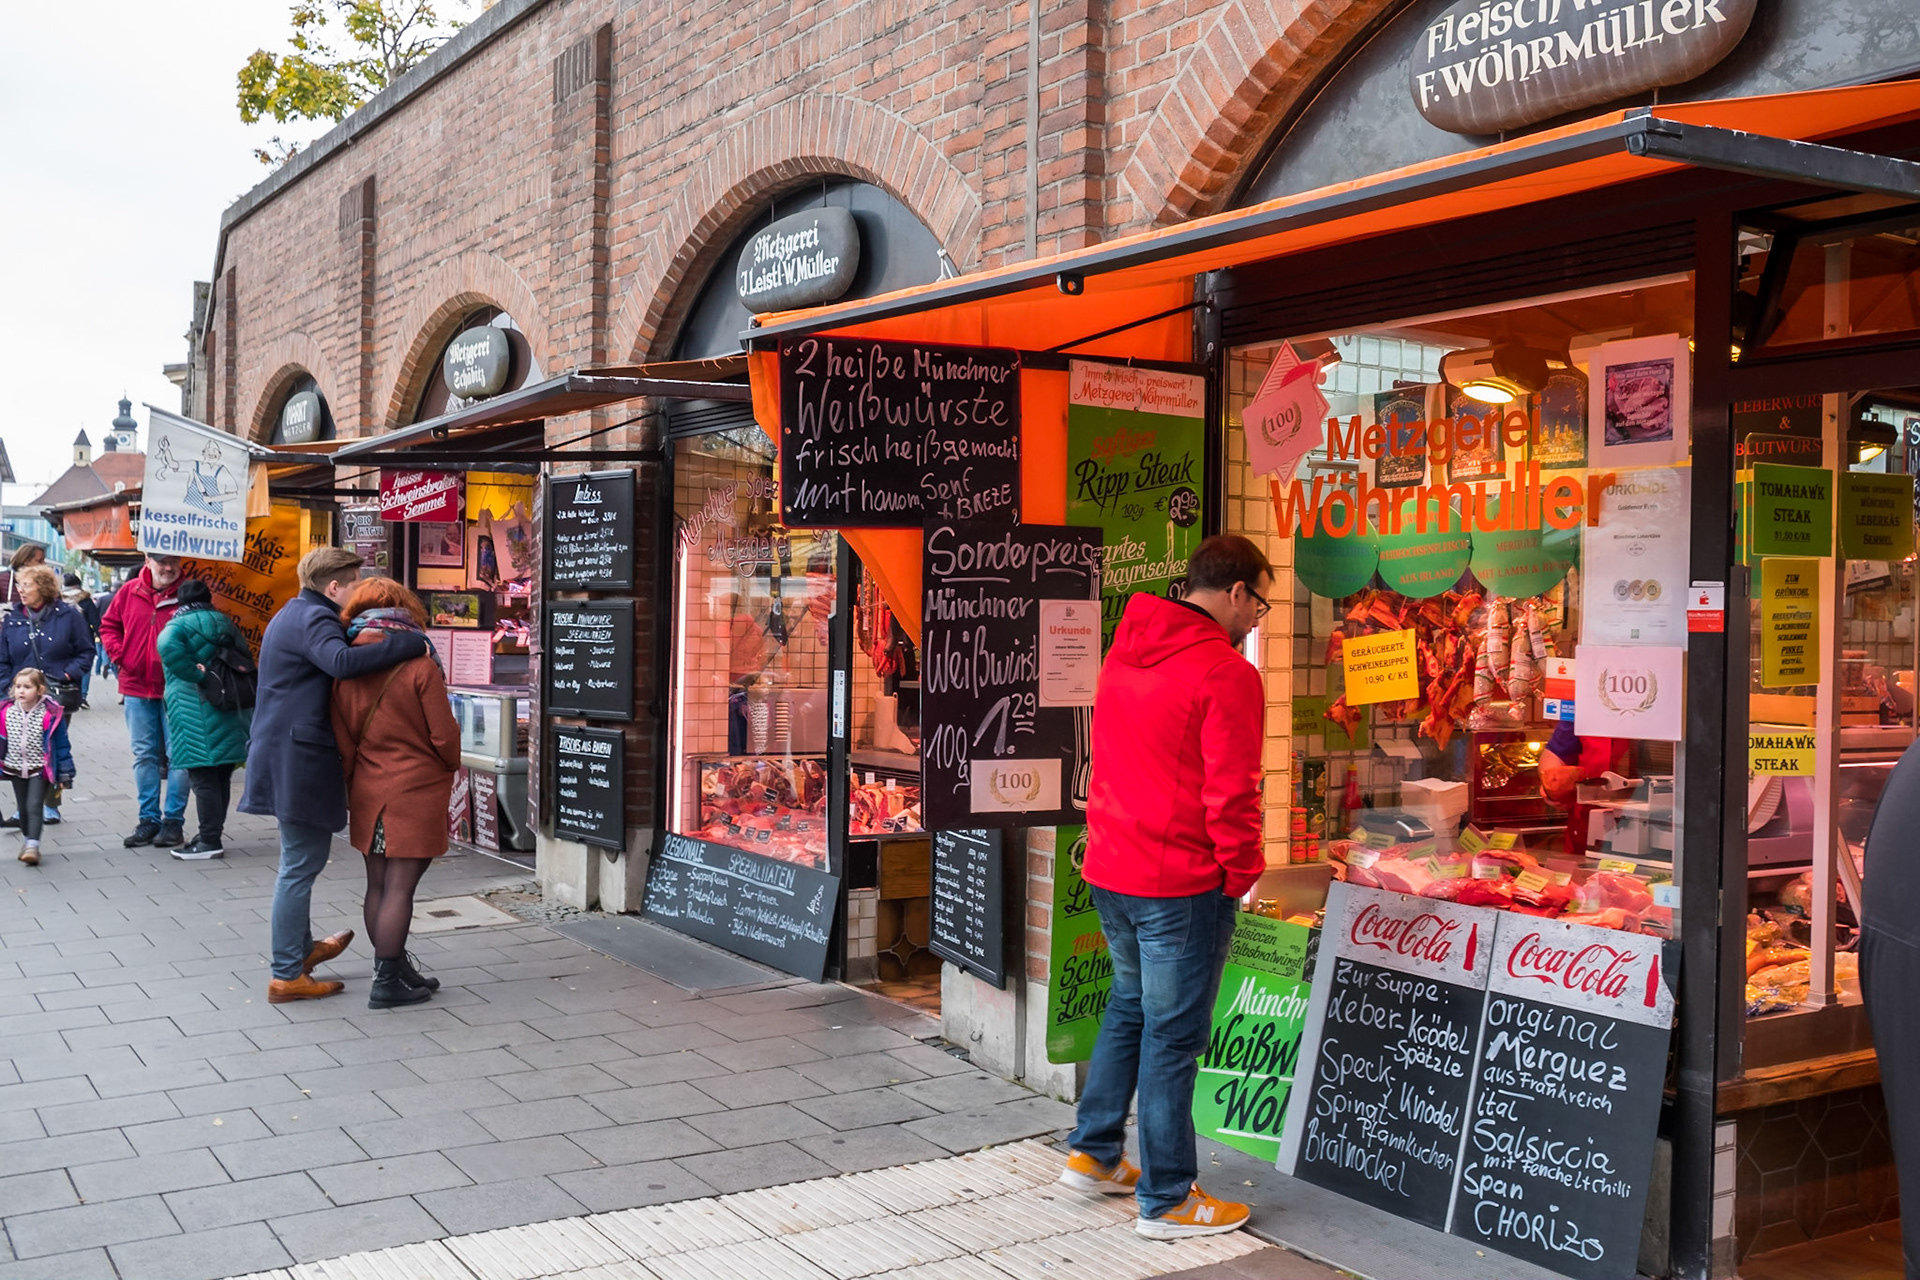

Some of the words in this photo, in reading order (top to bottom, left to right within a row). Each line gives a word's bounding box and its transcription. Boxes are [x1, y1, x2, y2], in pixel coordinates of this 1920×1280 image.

[754, 219, 820, 267] Metzgerei
[795, 339, 818, 378] 2
[826, 343, 906, 385] heiße
[913, 348, 1011, 383] Münchner
[798, 378, 1009, 441] Weißwürste
[1073, 381, 1136, 406] Metzgerei
[1136, 387, 1199, 414] Wöhrmüller
[1266, 407, 1295, 433] 100
[1326, 396, 1541, 465] Metzgerei
[1779, 416, 1792, 430] &
[795, 437, 878, 471] frisch
[1735, 439, 1821, 457] BLUTWURS
[573, 484, 602, 501] Imbiss
[1271, 461, 1617, 538] Wöhrmüller
[1760, 482, 1825, 500] TOMAHAWK
[144, 508, 239, 531] kesselfrische
[1773, 508, 1812, 524] STEAK
[143, 525, 239, 559] Weißwurst
[927, 526, 1093, 582] Sonderpreis
[1102, 535, 1148, 562] artes
[1399, 572, 1418, 585] AUS
[1419, 567, 1455, 582] IRLAND
[925, 587, 1034, 622] Münchner
[1050, 625, 1092, 636] Urkunde
[1351, 642, 1406, 658] GERÄUCHERTE
[1349, 656, 1409, 673] SCHWEINERIPPEN
[1364, 674, 1385, 685] 10,90
[1608, 674, 1648, 694] 100
[1748, 735, 1816, 749] OMAHAWK
[1754, 758, 1800, 770] STEAK
[999, 772, 1033, 790] 100
[663, 834, 707, 864] REGIONALE
[728, 853, 797, 889] SPEZIALITÄTEN
[1234, 925, 1278, 946] alsiccen
[1350, 903, 1461, 963] Coca-Cola
[1336, 960, 1371, 986] Zur
[1507, 932, 1640, 999] Coca-Cola
[1487, 999, 1619, 1050] Original
[1486, 1030, 1627, 1092] Merguez
[1483, 1066, 1516, 1087] aus
[1518, 1071, 1614, 1115] Frankreich
[1356, 1116, 1456, 1175] Pfannkuchen
[1472, 1118, 1617, 1176] Salsiccia
[1483, 1153, 1517, 1170] mit
[1462, 1161, 1525, 1201] Span
[1193, 1205, 1215, 1225] N
